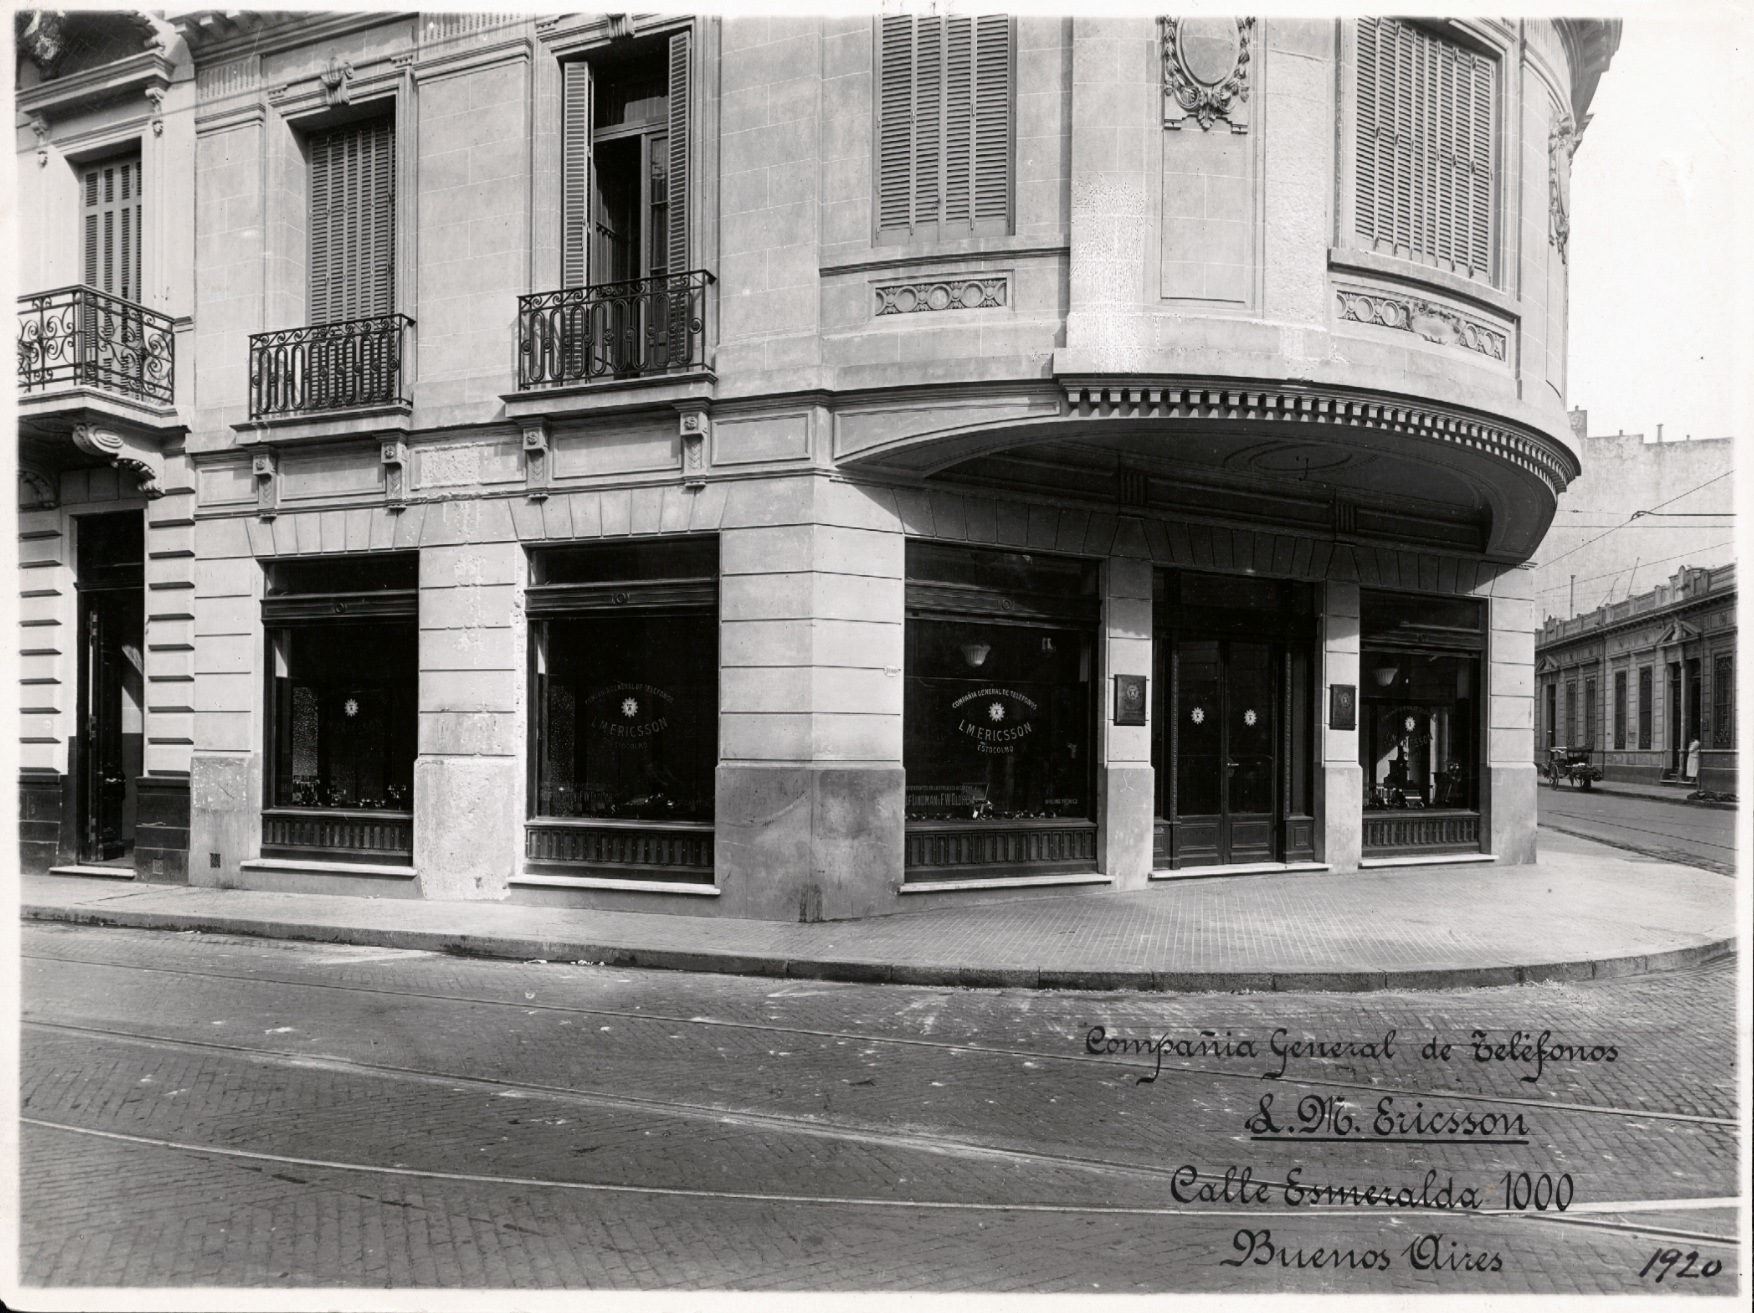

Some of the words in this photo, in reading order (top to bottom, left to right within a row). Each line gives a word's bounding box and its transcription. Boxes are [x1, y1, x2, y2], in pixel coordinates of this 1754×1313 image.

[977, 688, 1002, 697] GENERAL
[1002, 688, 1010, 697] DE
[977, 744, 1014, 754] ESTOCOLMO
